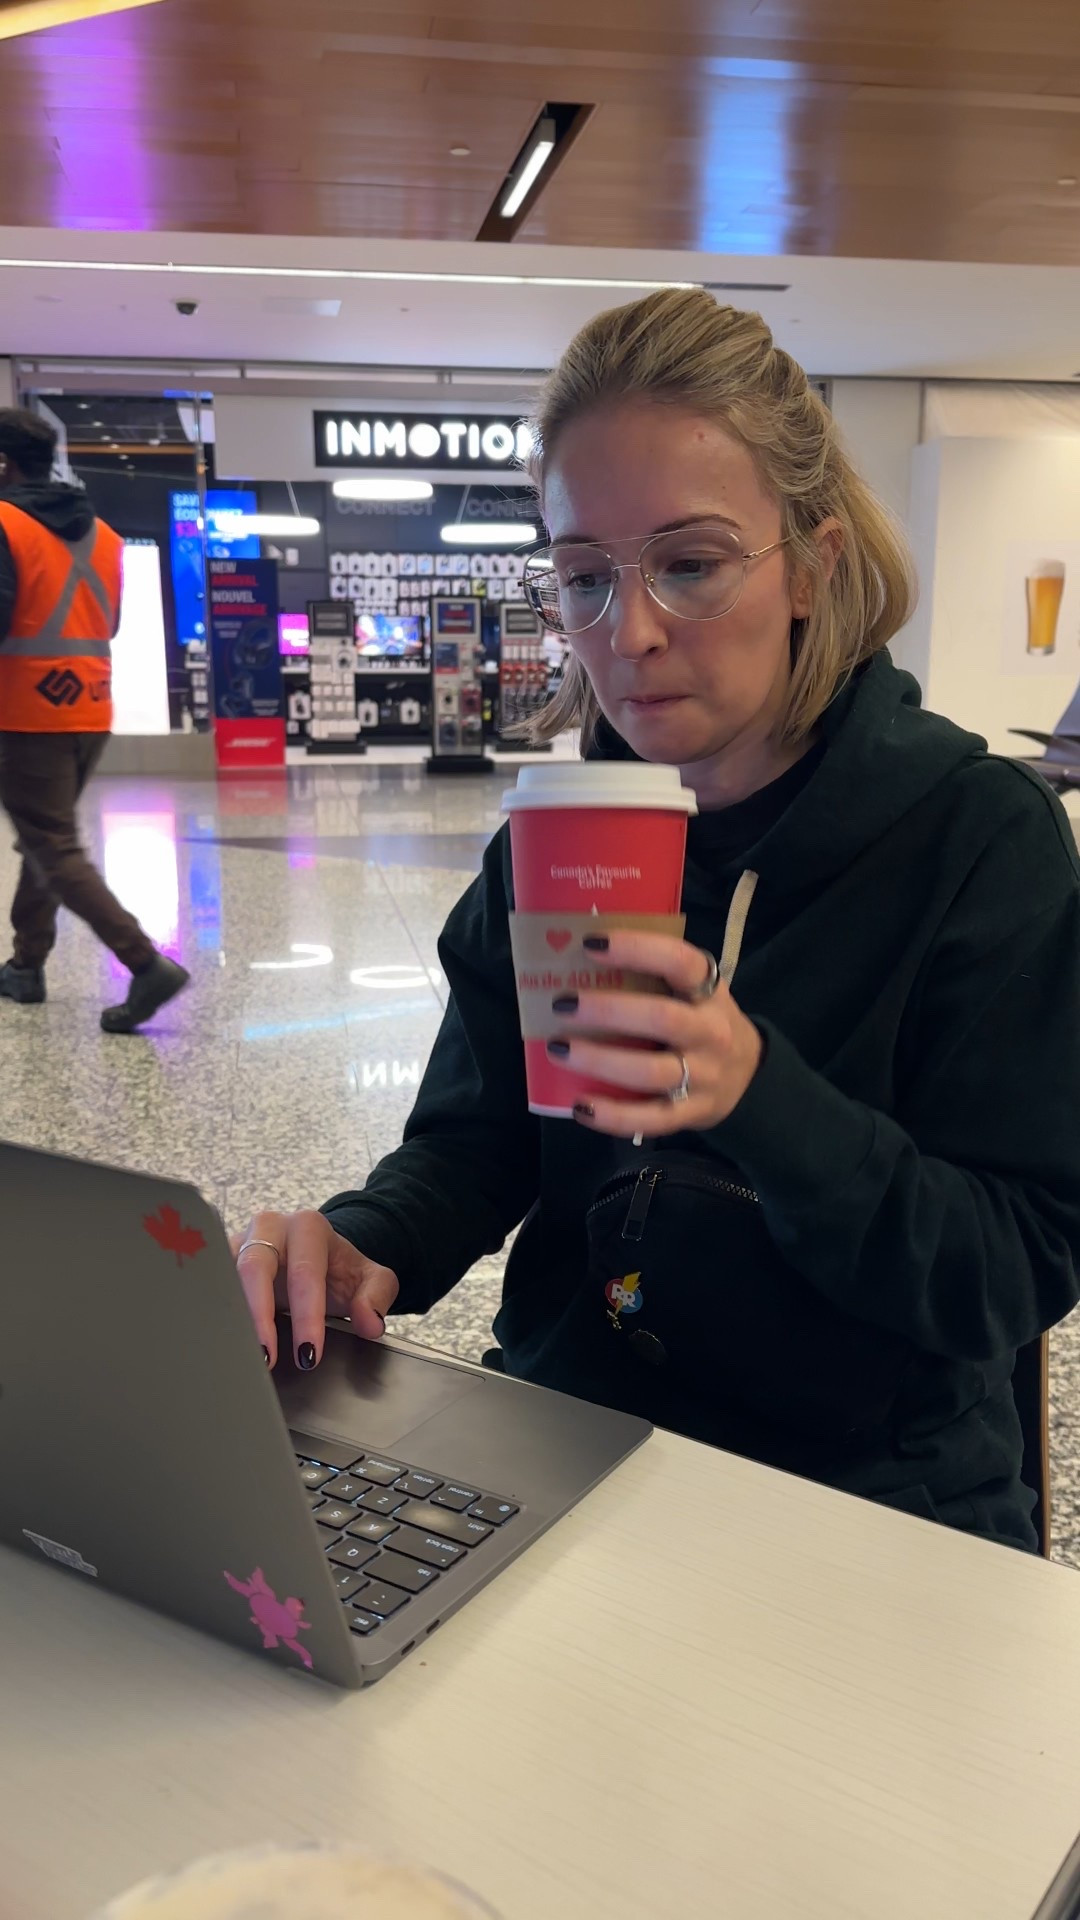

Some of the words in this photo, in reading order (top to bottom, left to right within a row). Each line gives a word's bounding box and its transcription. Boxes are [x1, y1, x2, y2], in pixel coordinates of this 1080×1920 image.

[335, 498, 435, 516] CONNECT
[210, 561, 237, 574] NEW
[211, 590, 256, 603] NOUVEL
[367, 1459, 401, 1473] command
[412, 1474, 436, 1484] option
[341, 1484, 353, 1492] X
[447, 1486, 474, 1498] control
[377, 1496, 389, 1505] Z
[330, 1510, 342, 1518] S
[368, 1523, 380, 1531] A
[467, 1522, 486, 1532] shift
[425, 1538, 442, 1548] lock
[347, 1548, 359, 1557] Q
[440, 1543, 460, 1554] caps
[417, 1568, 432, 1577] tab
[354, 1616, 370, 1626] esc
